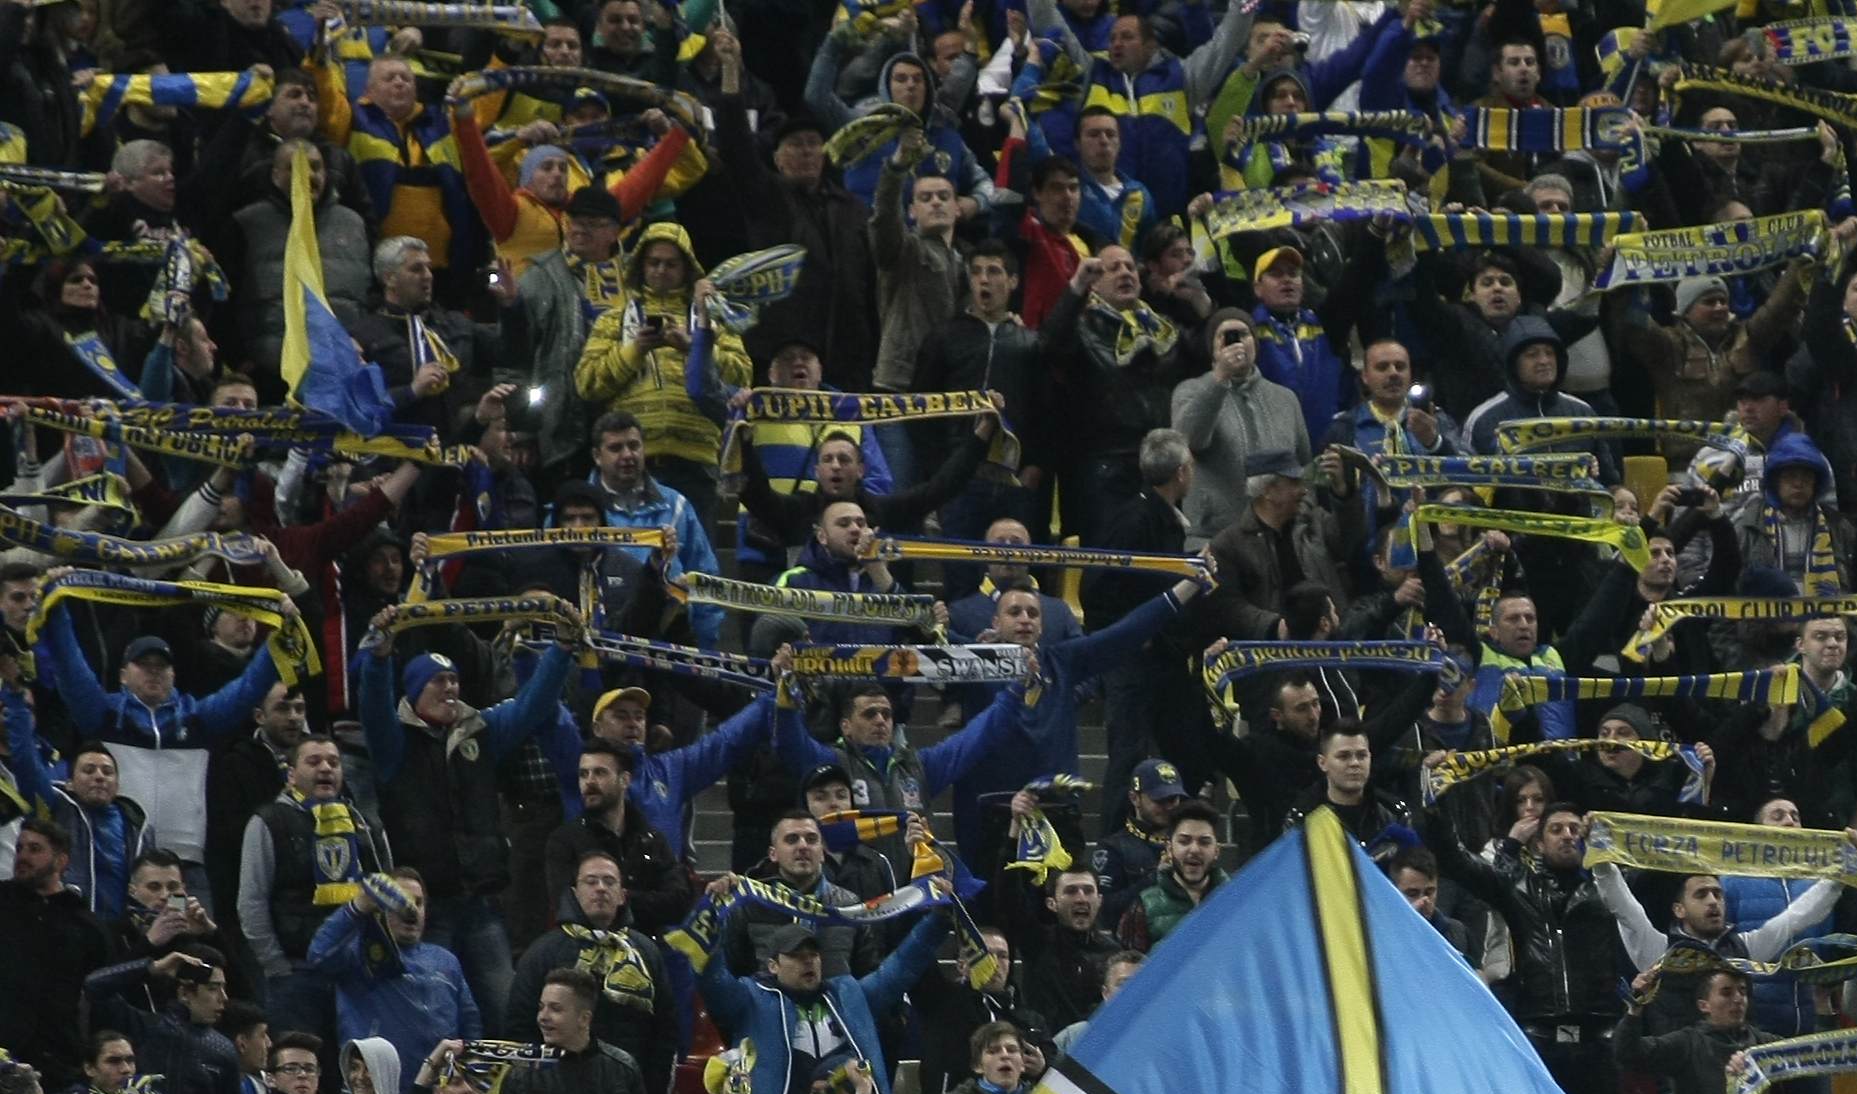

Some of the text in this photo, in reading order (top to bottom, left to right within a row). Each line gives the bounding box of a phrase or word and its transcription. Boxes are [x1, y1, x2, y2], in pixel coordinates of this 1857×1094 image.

[1789, 26, 1836, 57] FC
[1643, 231, 1695, 248] FOTBAL
[748, 391, 996, 420] LUPII GALBEN
[1464, 458, 1590, 480] GALBEN
